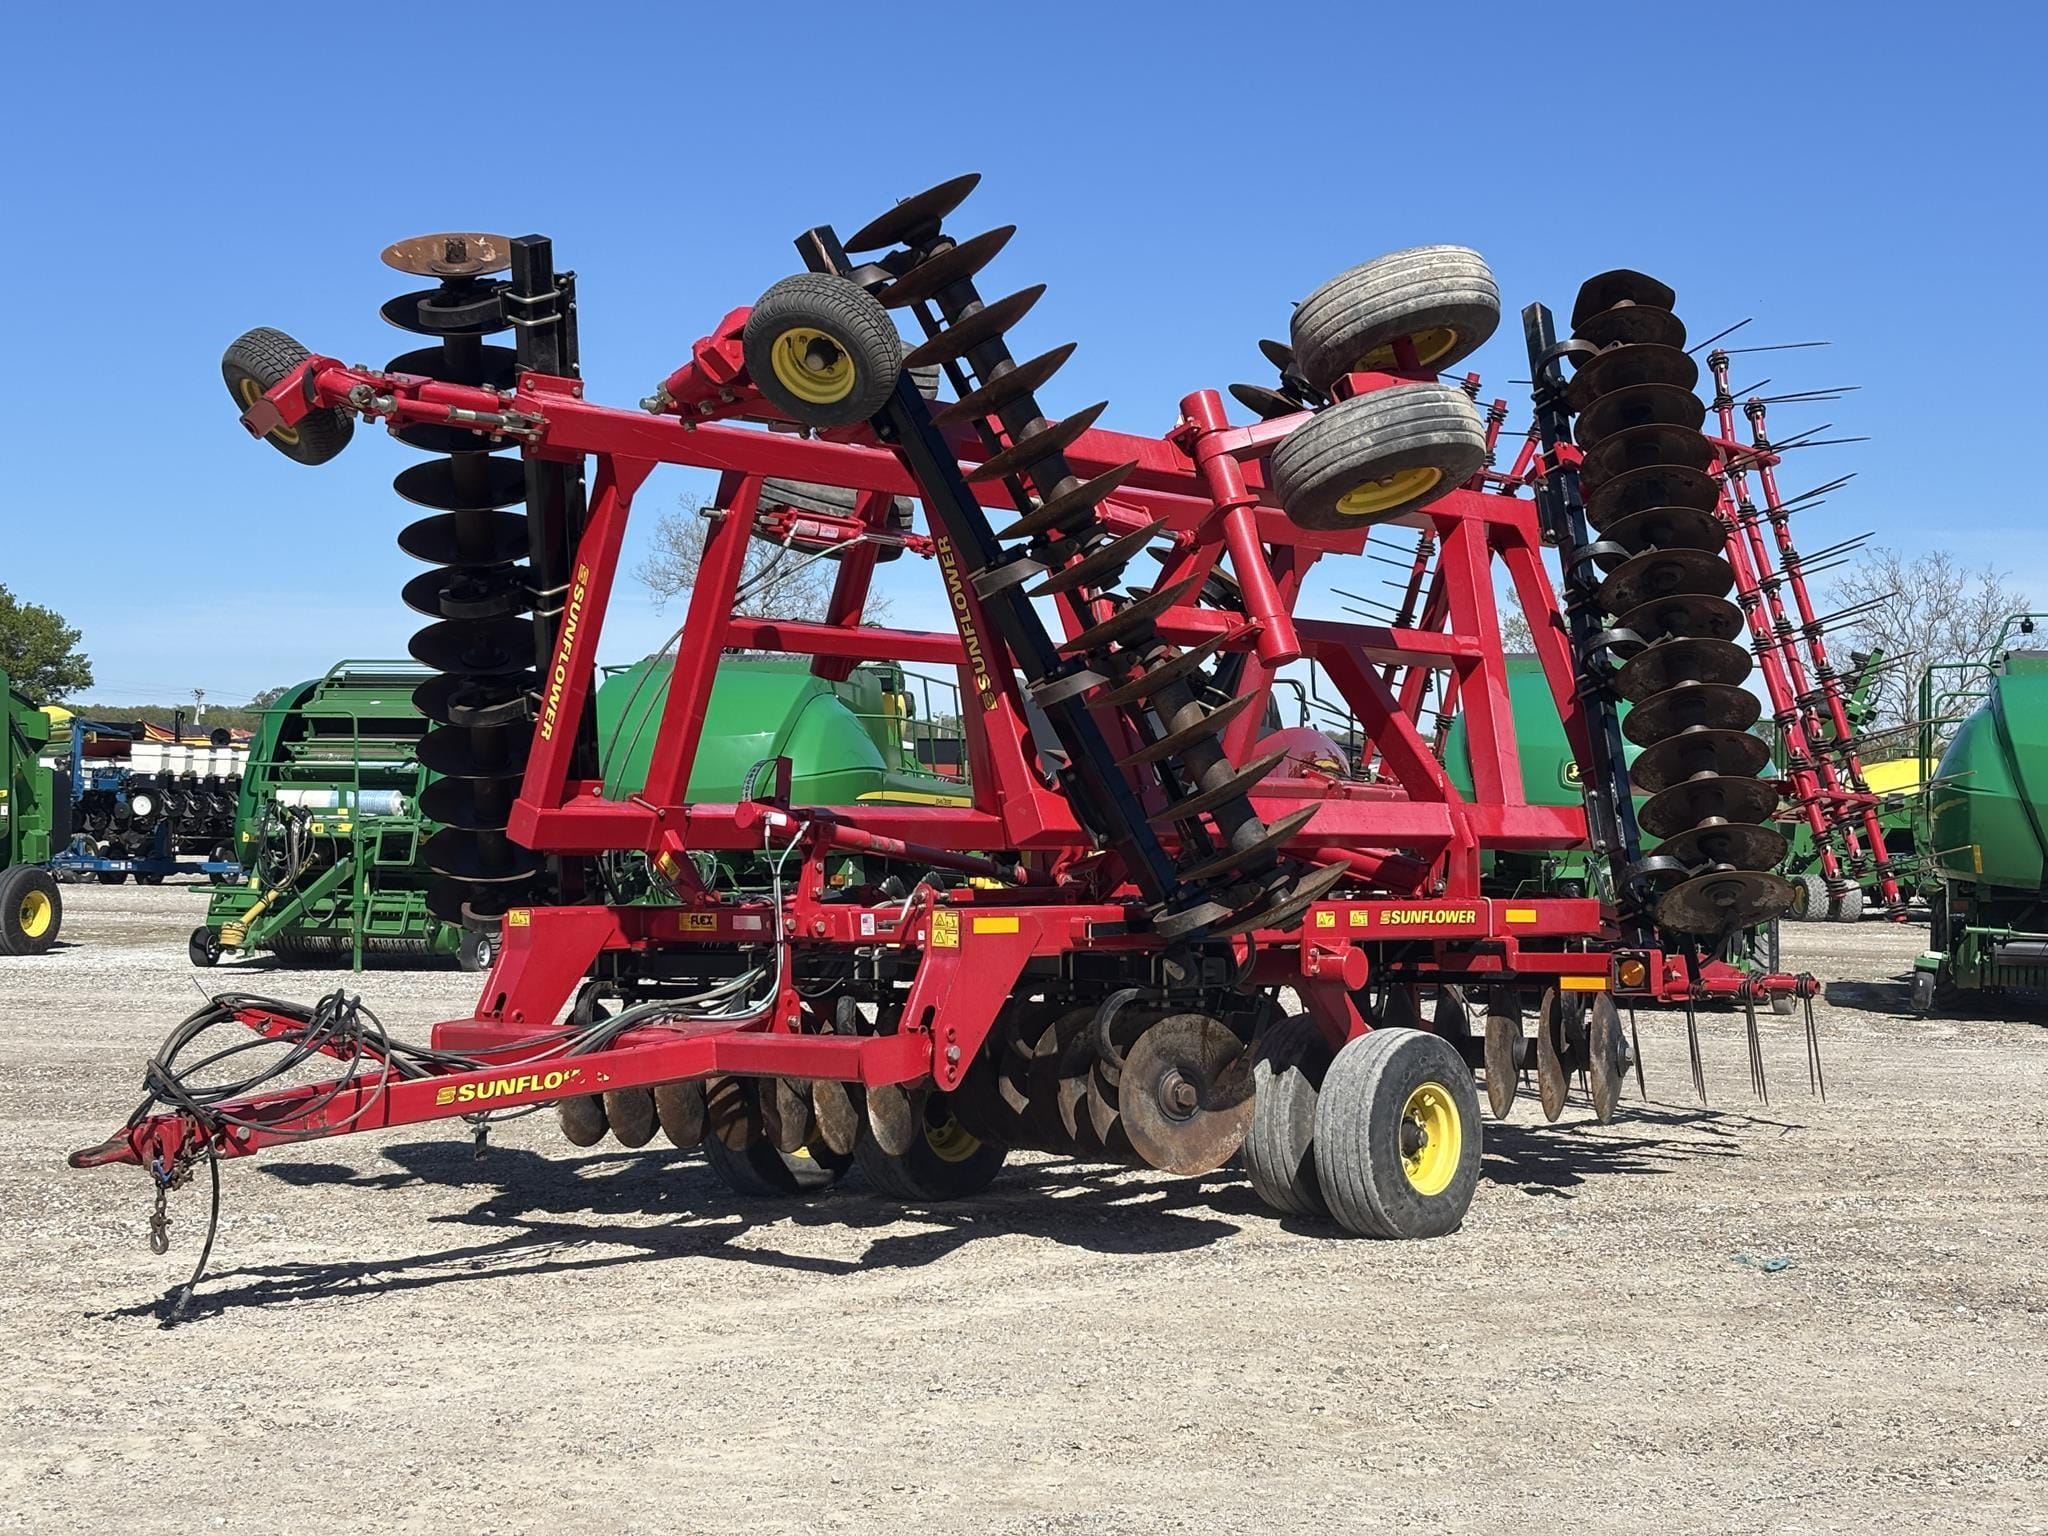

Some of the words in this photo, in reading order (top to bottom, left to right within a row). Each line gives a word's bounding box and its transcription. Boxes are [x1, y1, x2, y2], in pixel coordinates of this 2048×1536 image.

[938, 535, 992, 692] SUNFLOWER
[541, 583, 585, 741] SUNFLOWER
[690, 914, 713, 925] FLEX
[1390, 909, 1476, 924] SUNFLOWER
[457, 1069, 610, 1102] SUNFLO
